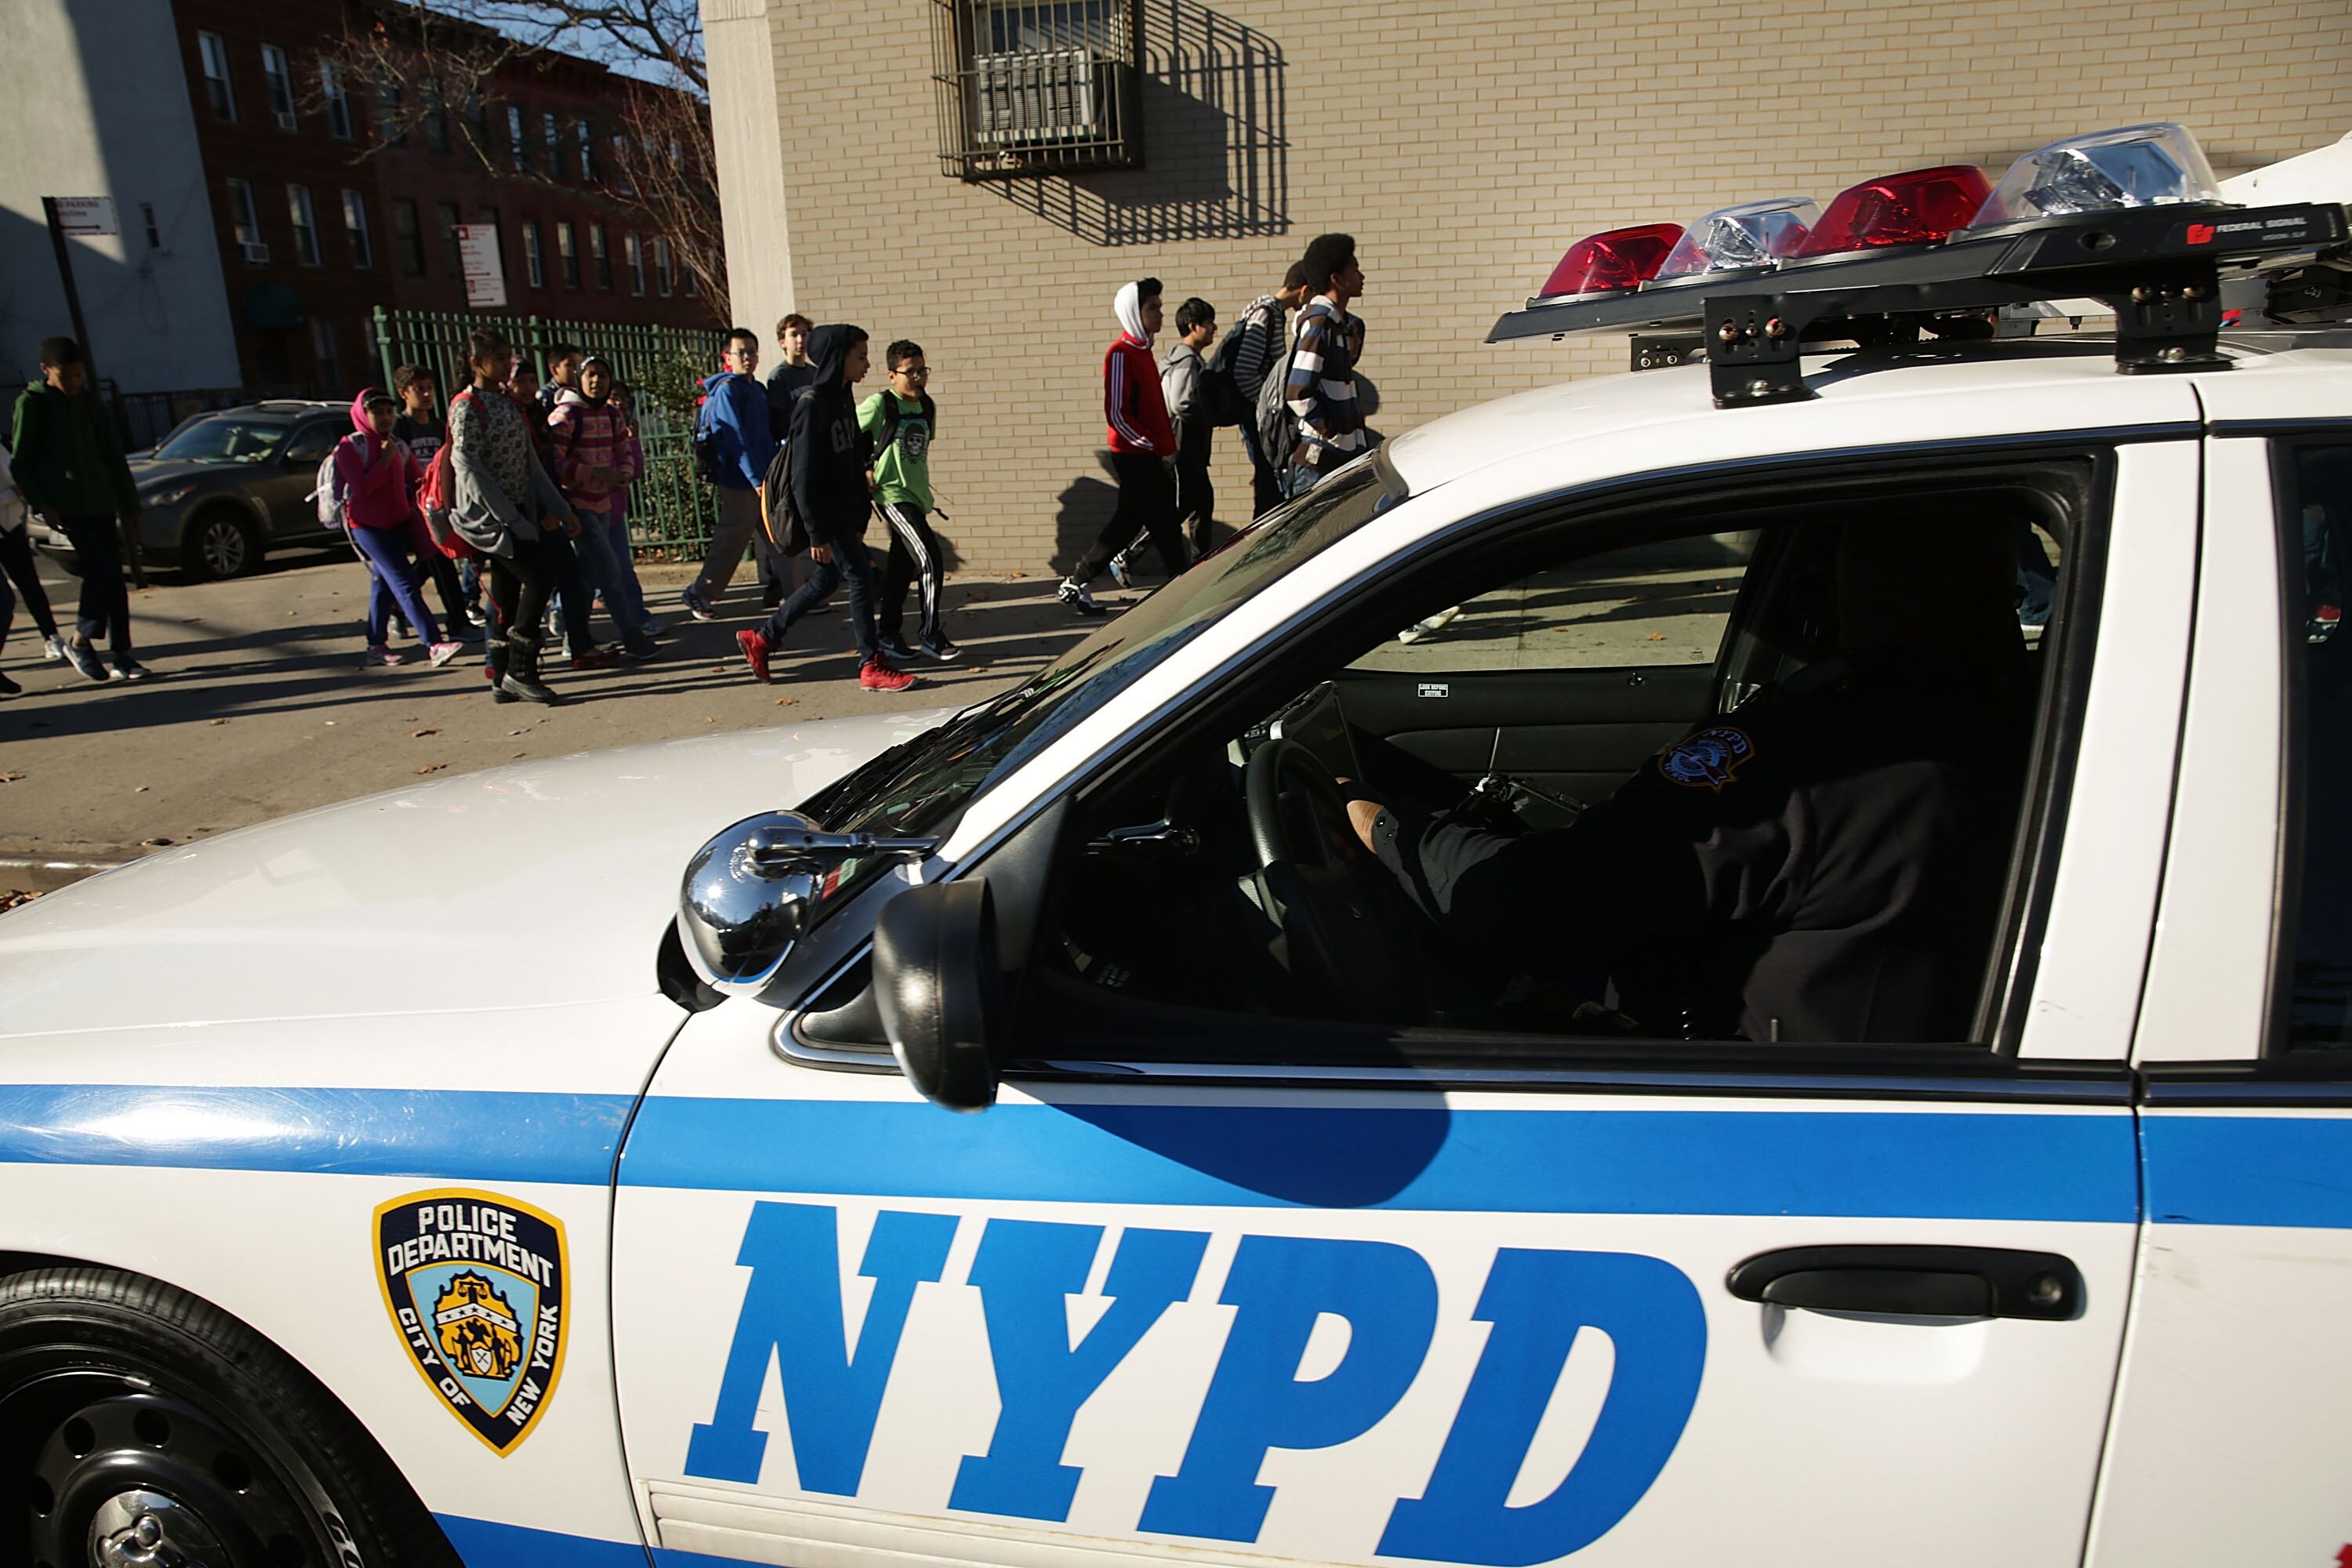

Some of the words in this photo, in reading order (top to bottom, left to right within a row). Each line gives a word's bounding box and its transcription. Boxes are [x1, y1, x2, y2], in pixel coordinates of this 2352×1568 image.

[2216, 221, 2264, 233] FEDERAL
[2265, 216, 2308, 228] SIGNAL
[1702, 729, 1748, 753] NYPD
[418, 1204, 517, 1243] POLICE
[387, 1232, 554, 1287] DEPARTMENT
[397, 1307, 441, 1366] CITY
[439, 1377, 471, 1406] OF
[506, 1376, 541, 1426] NEW
[532, 1305, 559, 1369] YORK
[684, 1200, 1708, 1568] NYPD
